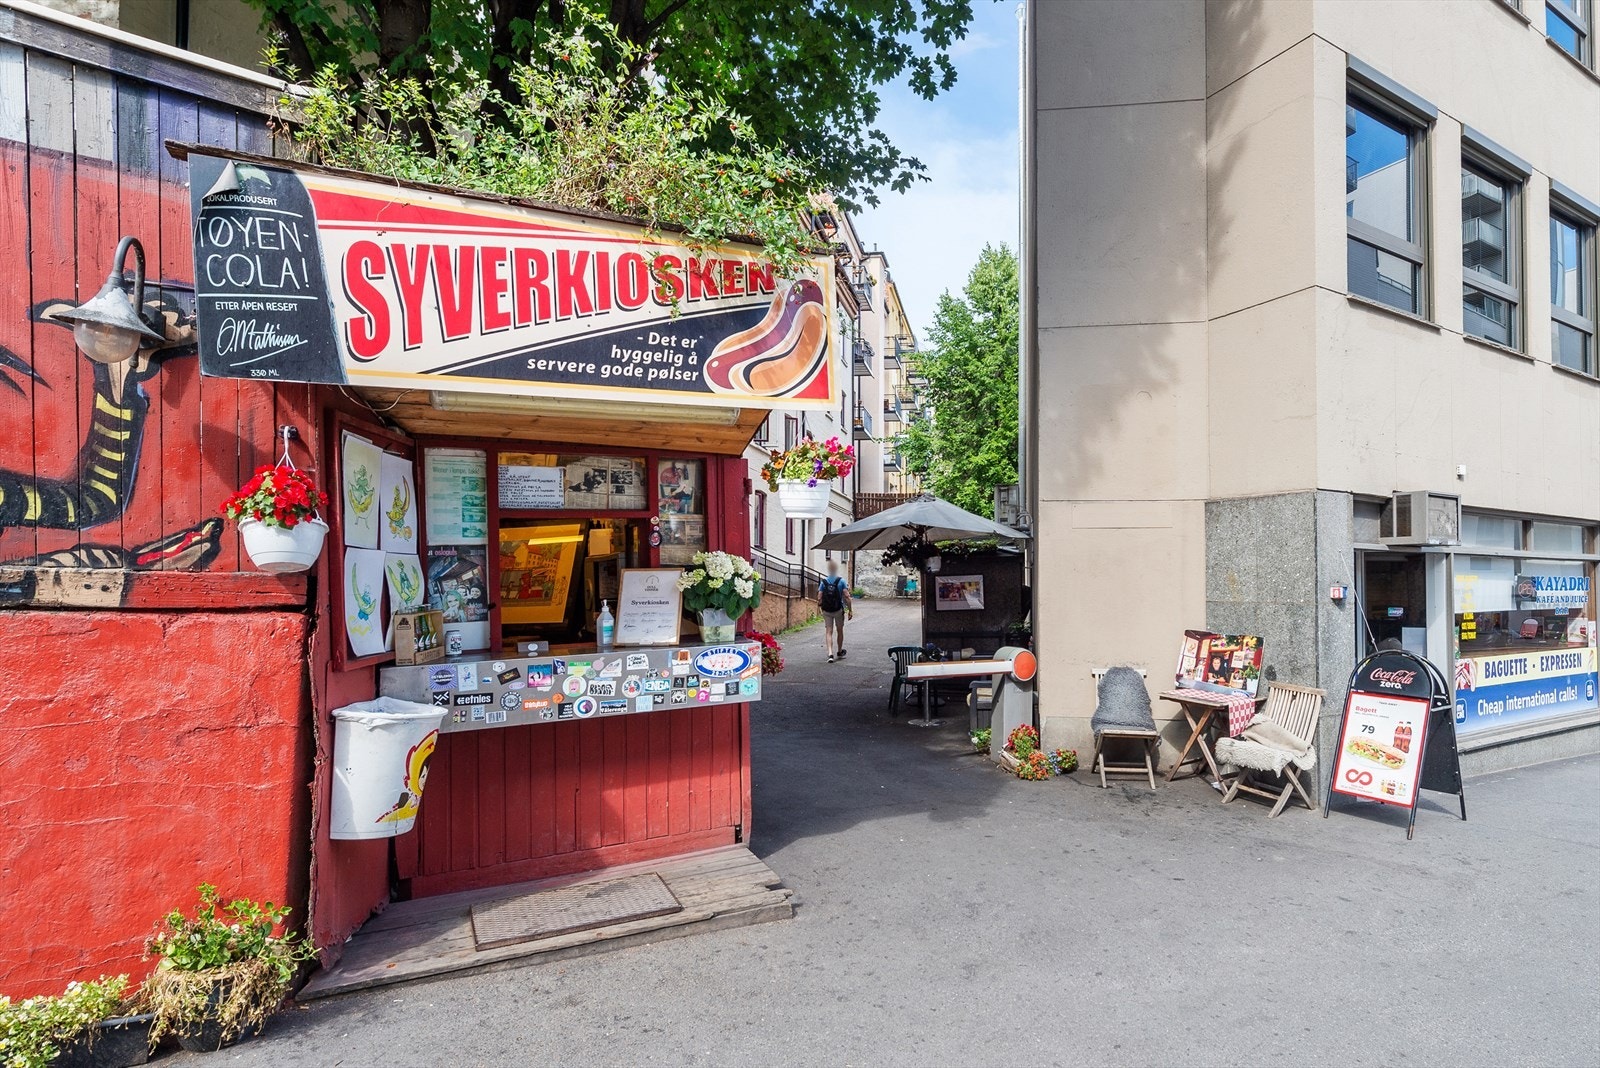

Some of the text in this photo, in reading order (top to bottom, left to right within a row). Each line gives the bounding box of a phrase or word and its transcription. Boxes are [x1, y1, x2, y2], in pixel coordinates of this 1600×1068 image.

[206, 254, 310, 289] COLA!
[215, 300, 298, 312] ETTER ÅPEN RESEPT
[340, 239, 777, 362] SYVERKIOSKEN
[648, 332, 677, 347] Det
[681, 338, 698, 348] er
[611, 344, 698, 367] hyggelig å
[268, 369, 280, 377] ML
[527, 358, 699, 381] servere gode pølser
[1535, 576, 1590, 591] KAYADRI
[1536, 595, 1588, 603] KAFE AND JUICE
[1484, 652, 1582, 679] BAGUETTE EXPRESSEN
[465, 694, 491, 704] etnies
[1477, 684, 1578, 716] Cheap international calls!
[1355, 705, 1377, 714] Bagett
[1361, 724, 1375, 734] 79
